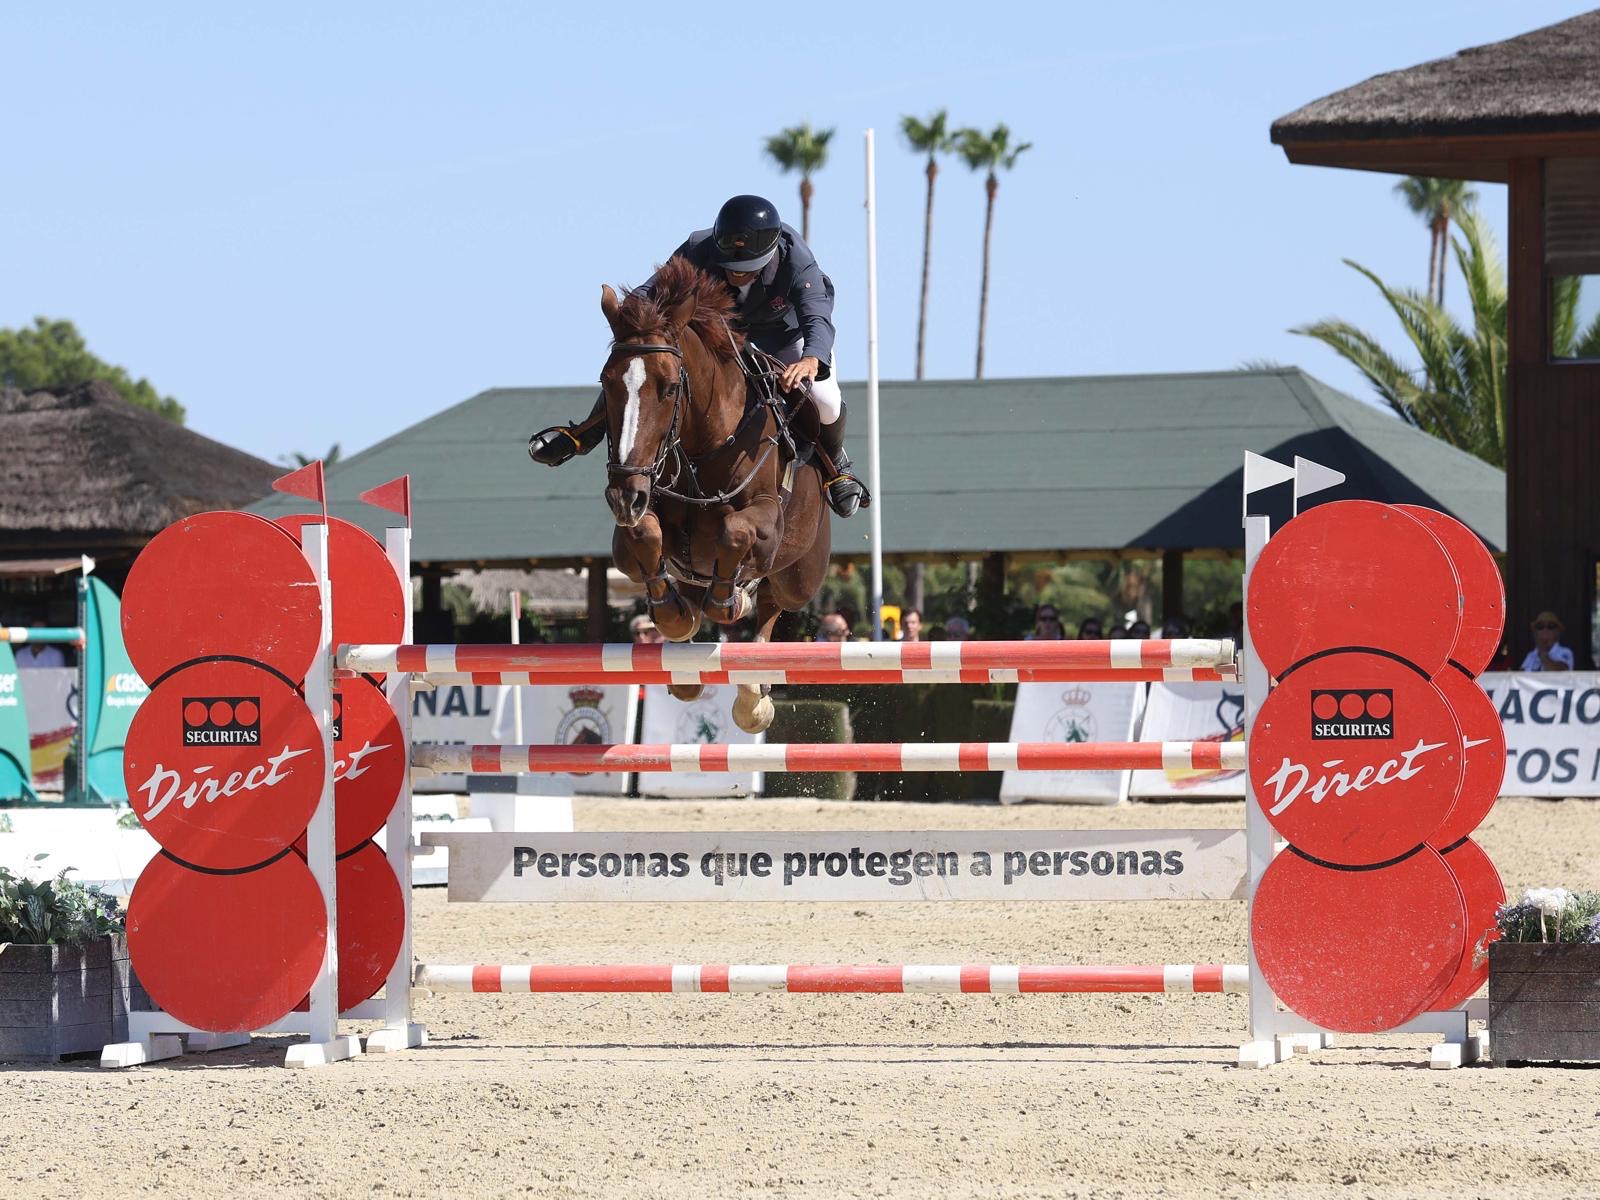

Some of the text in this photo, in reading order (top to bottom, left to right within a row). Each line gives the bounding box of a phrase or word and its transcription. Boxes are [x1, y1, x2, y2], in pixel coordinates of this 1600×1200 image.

[116, 673, 148, 692] case
[1487, 687, 1600, 725] ACIO
[186, 730, 258, 743] SECURITAS
[1315, 723, 1391, 737] SECURITAS
[137, 744, 313, 822] Direct
[1263, 738, 1448, 817] Direct
[513, 846, 1185, 887] Personas que protegen a personas
